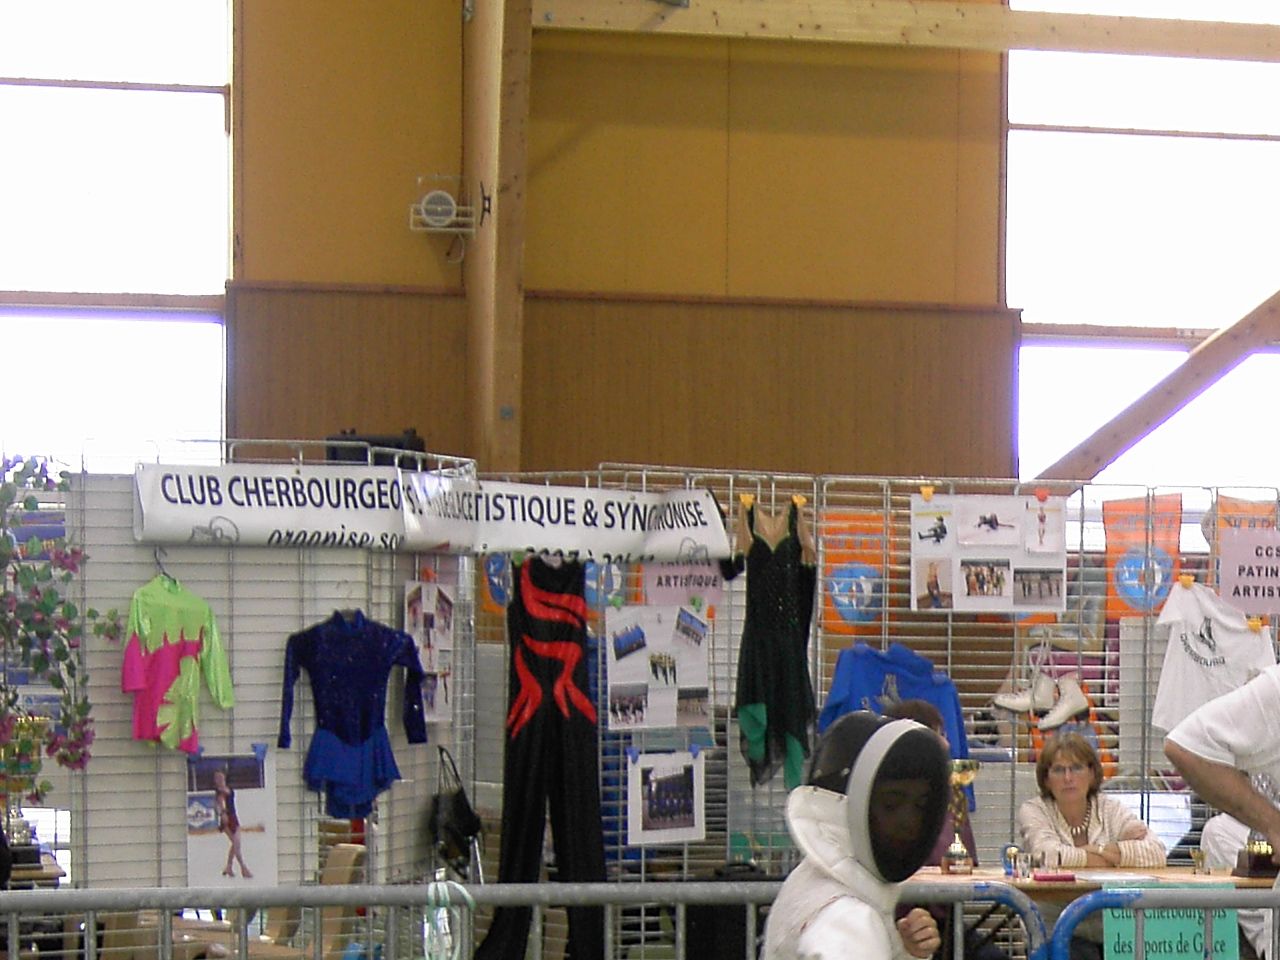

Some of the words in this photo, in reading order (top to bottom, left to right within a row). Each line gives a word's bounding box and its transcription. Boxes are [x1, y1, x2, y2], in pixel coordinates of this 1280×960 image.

[161, 473, 223, 506] CLUB
[228, 476, 416, 514] CHERBOURGEOS
[475, 491, 576, 528] TISTIQUE
[582, 499, 599, 528] &
[656, 574, 718, 588] ARTISTIQUE
[1111, 908, 1136, 920] Clu
[1143, 908, 1227, 925] Cherbourgois
[1113, 932, 1133, 954] des
[1143, 938, 1173, 960] ports
[1176, 932, 1190, 954] de
[1193, 932, 1226, 954] Gce
